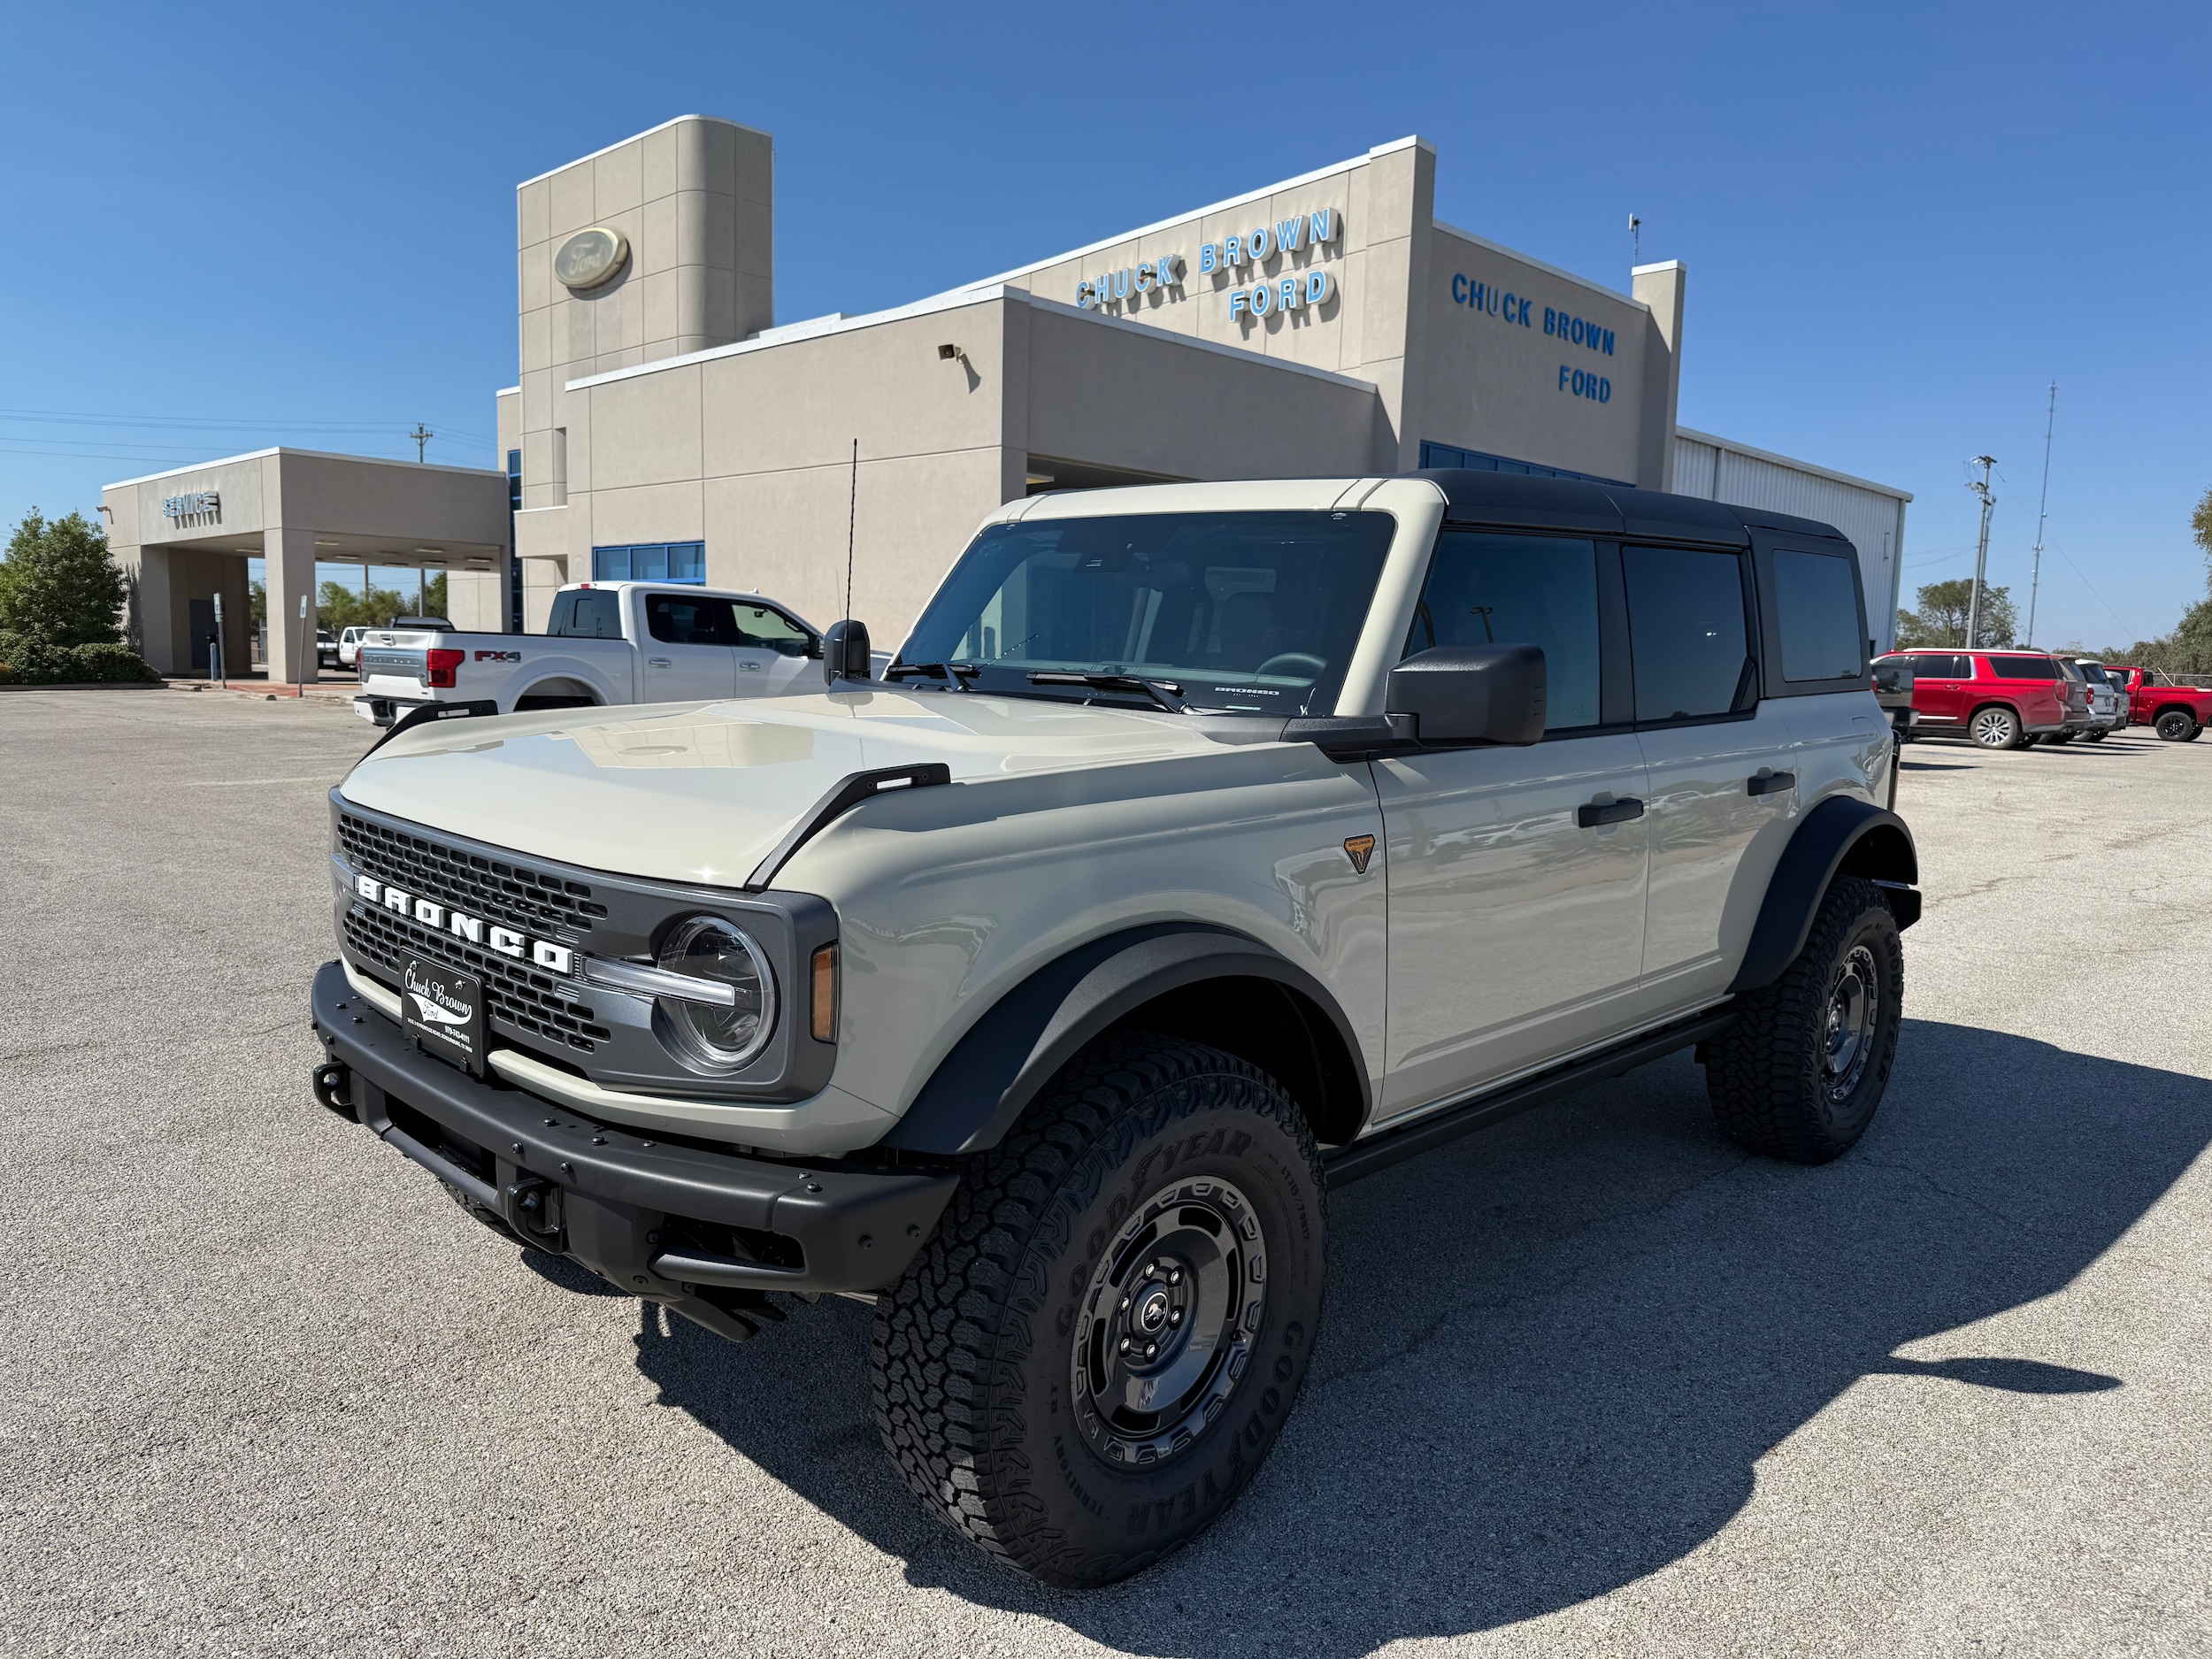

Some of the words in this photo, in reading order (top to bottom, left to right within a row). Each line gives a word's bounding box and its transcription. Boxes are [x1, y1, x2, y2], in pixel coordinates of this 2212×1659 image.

[568, 242, 605, 275] Ford
[1076, 253, 1179, 311] CHUCK
[1199, 207, 1336, 276] BROWN
[1228, 269, 1333, 324] FORD
[1452, 273, 1533, 328] CHUCK
[1543, 306, 1616, 357] BROWN
[1559, 365, 1612, 404] FORD
[162, 491, 215, 518] SERVICE
[474, 649, 522, 662] FX4
[1215, 687, 1280, 695] BRONCO
[357, 874, 574, 975] BRONCO
[404, 968, 432, 998] Chuck
[432, 981, 472, 1016] Brown
[423, 1000, 439, 1019] Ford
[1050, 1383, 1059, 1414] RT
[1053, 1434, 1104, 1518] TERRITORY
